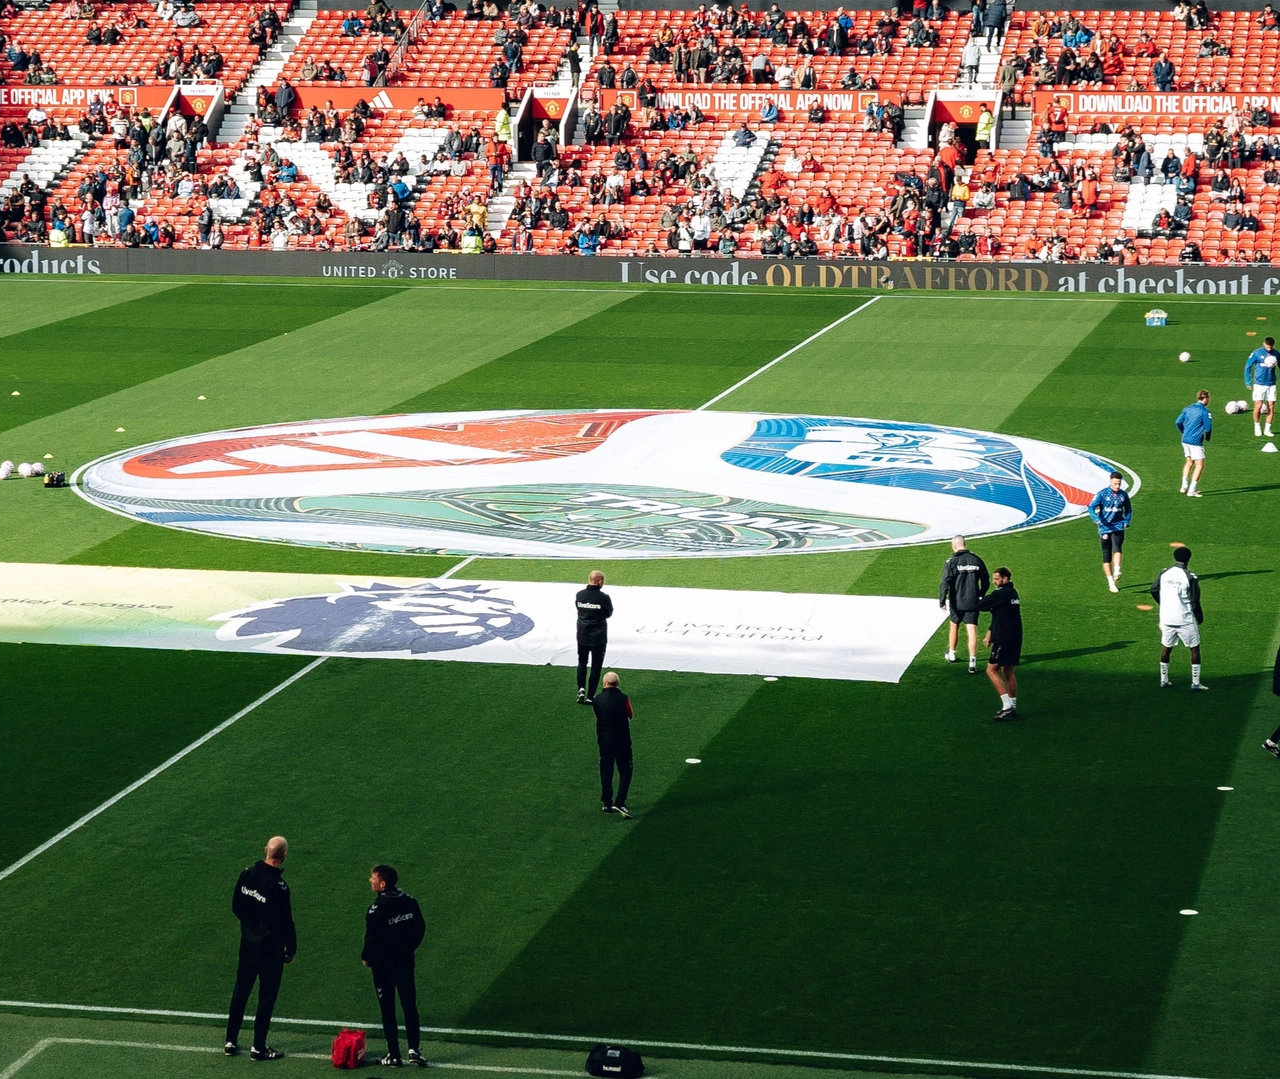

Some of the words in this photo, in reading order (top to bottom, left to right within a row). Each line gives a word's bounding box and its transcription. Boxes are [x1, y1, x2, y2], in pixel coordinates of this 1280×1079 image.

[10, 88, 60, 105] OFFICIAL
[61, 88, 85, 105] APP
[655, 92, 711, 110] WNLOAD
[712, 92, 738, 110] THE
[823, 93, 853, 111] NOW
[1079, 94, 1153, 113] DOWNLOAD
[1154, 95, 1181, 113] THE
[1182, 95, 1237, 113] OFFICIAL
[322, 265, 377, 279] UNITED
[409, 266, 457, 279] STORE
[618, 261, 677, 284] Use
[684, 261, 758, 286] code
[765, 263, 1049, 291] OLDTRAFFORD
[1057, 270, 1089, 292] at
[1097, 268, 1252, 296] checkout
[846, 454, 934, 466] FIFA
[568, 491, 877, 538] TRIONDA
[61, 599, 174, 610] League
[666, 621, 725, 630] Live
[734, 624, 806, 633] from
[702, 630, 824, 642] Trafford
